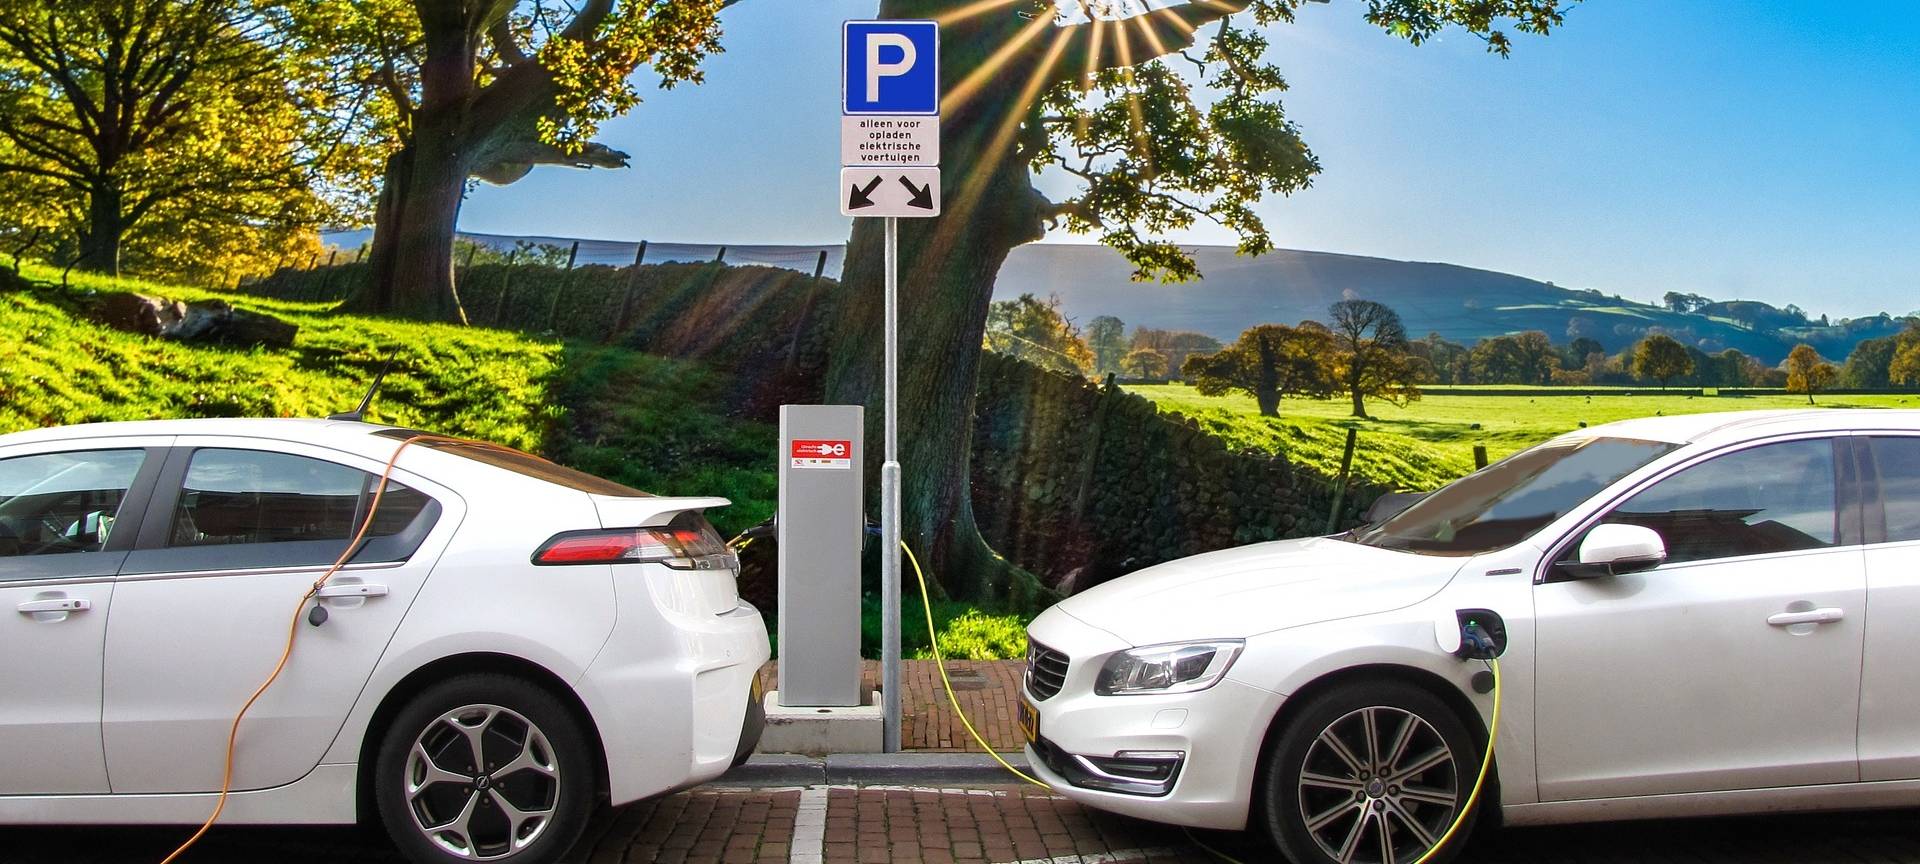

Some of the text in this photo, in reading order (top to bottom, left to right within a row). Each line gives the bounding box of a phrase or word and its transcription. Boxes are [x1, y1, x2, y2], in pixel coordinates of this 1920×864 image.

[866, 33, 917, 102] P
[860, 119, 892, 128] alleen
[869, 131, 912, 140] opladen
[859, 142, 921, 150] elektrische
[861, 153, 920, 164] voertuigen
